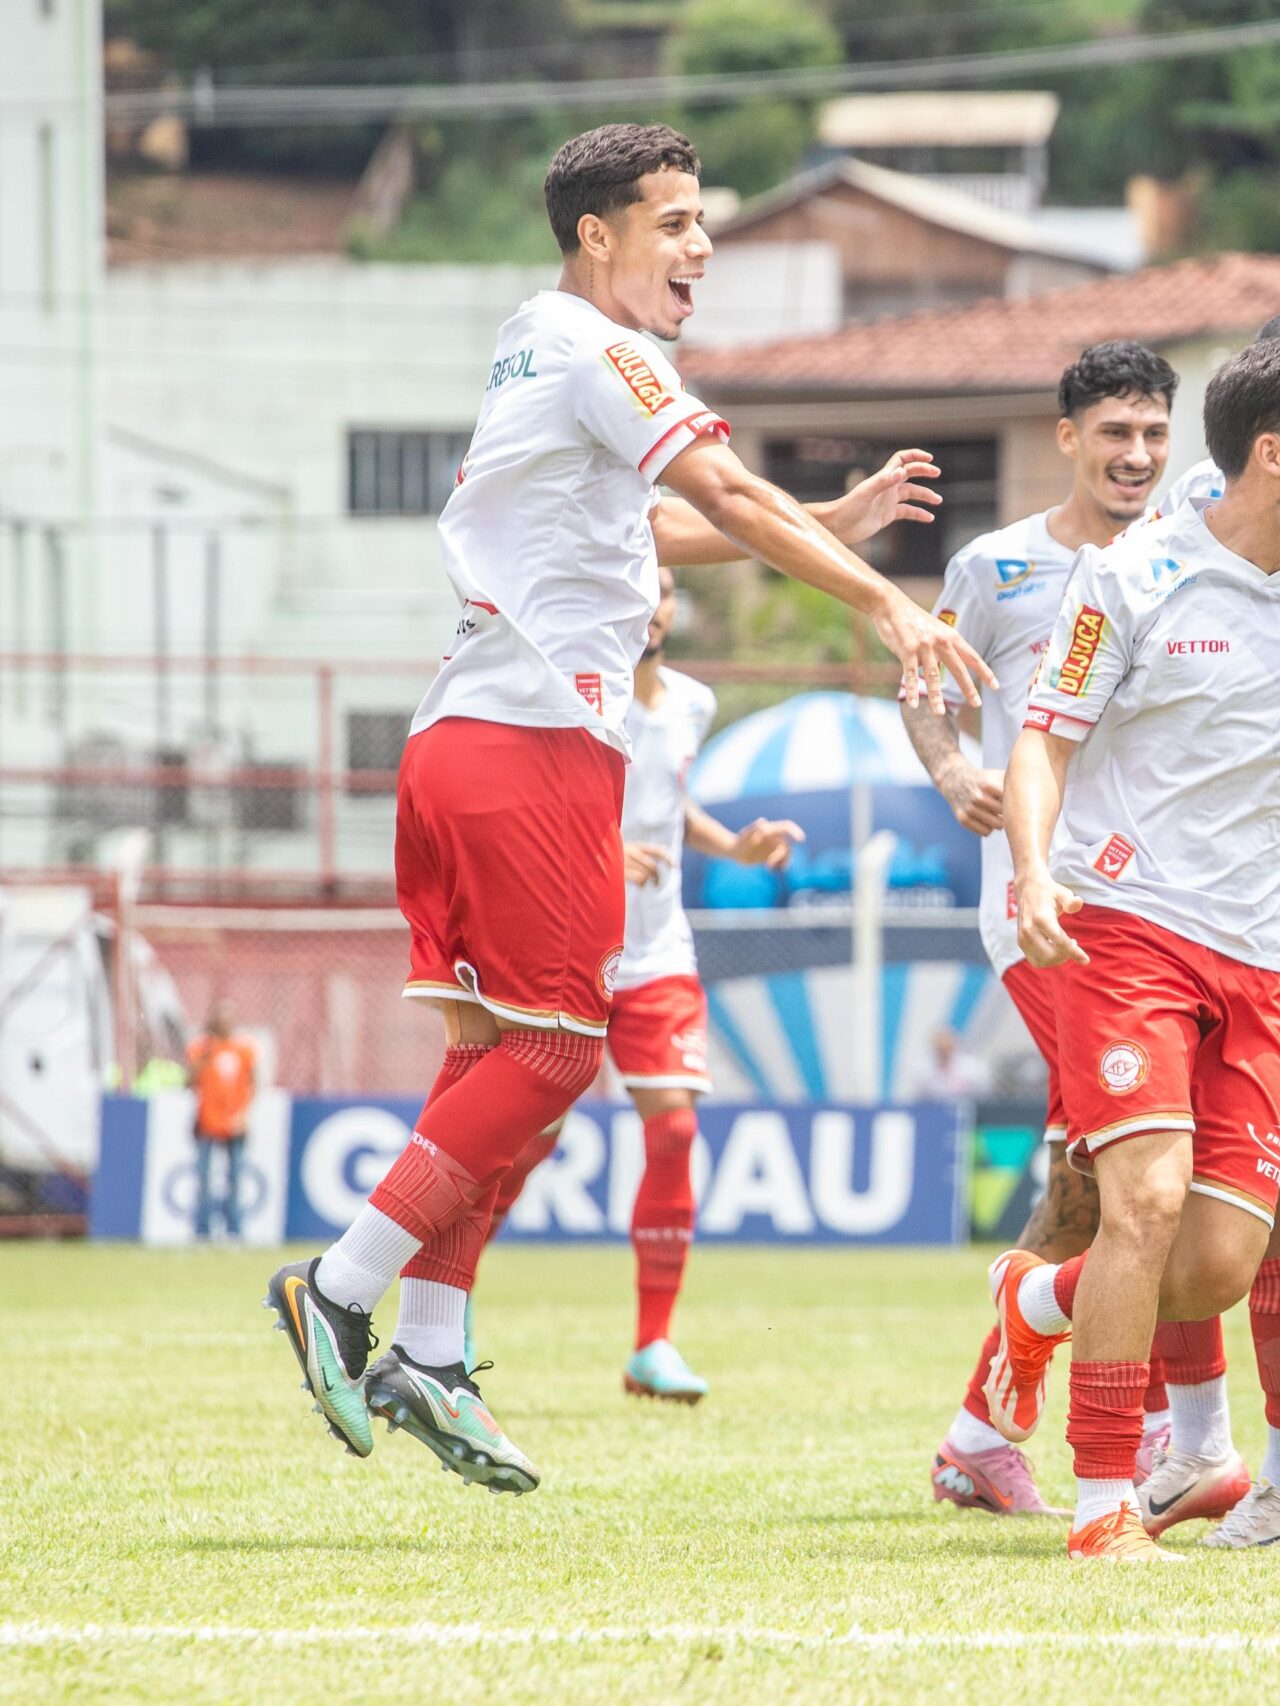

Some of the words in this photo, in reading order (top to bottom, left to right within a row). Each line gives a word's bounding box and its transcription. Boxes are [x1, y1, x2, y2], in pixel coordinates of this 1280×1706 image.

[486, 350, 537, 391] RESOL
[1058, 612, 1101, 695] DUJUCA
[1167, 640, 1230, 655] VETTOR
